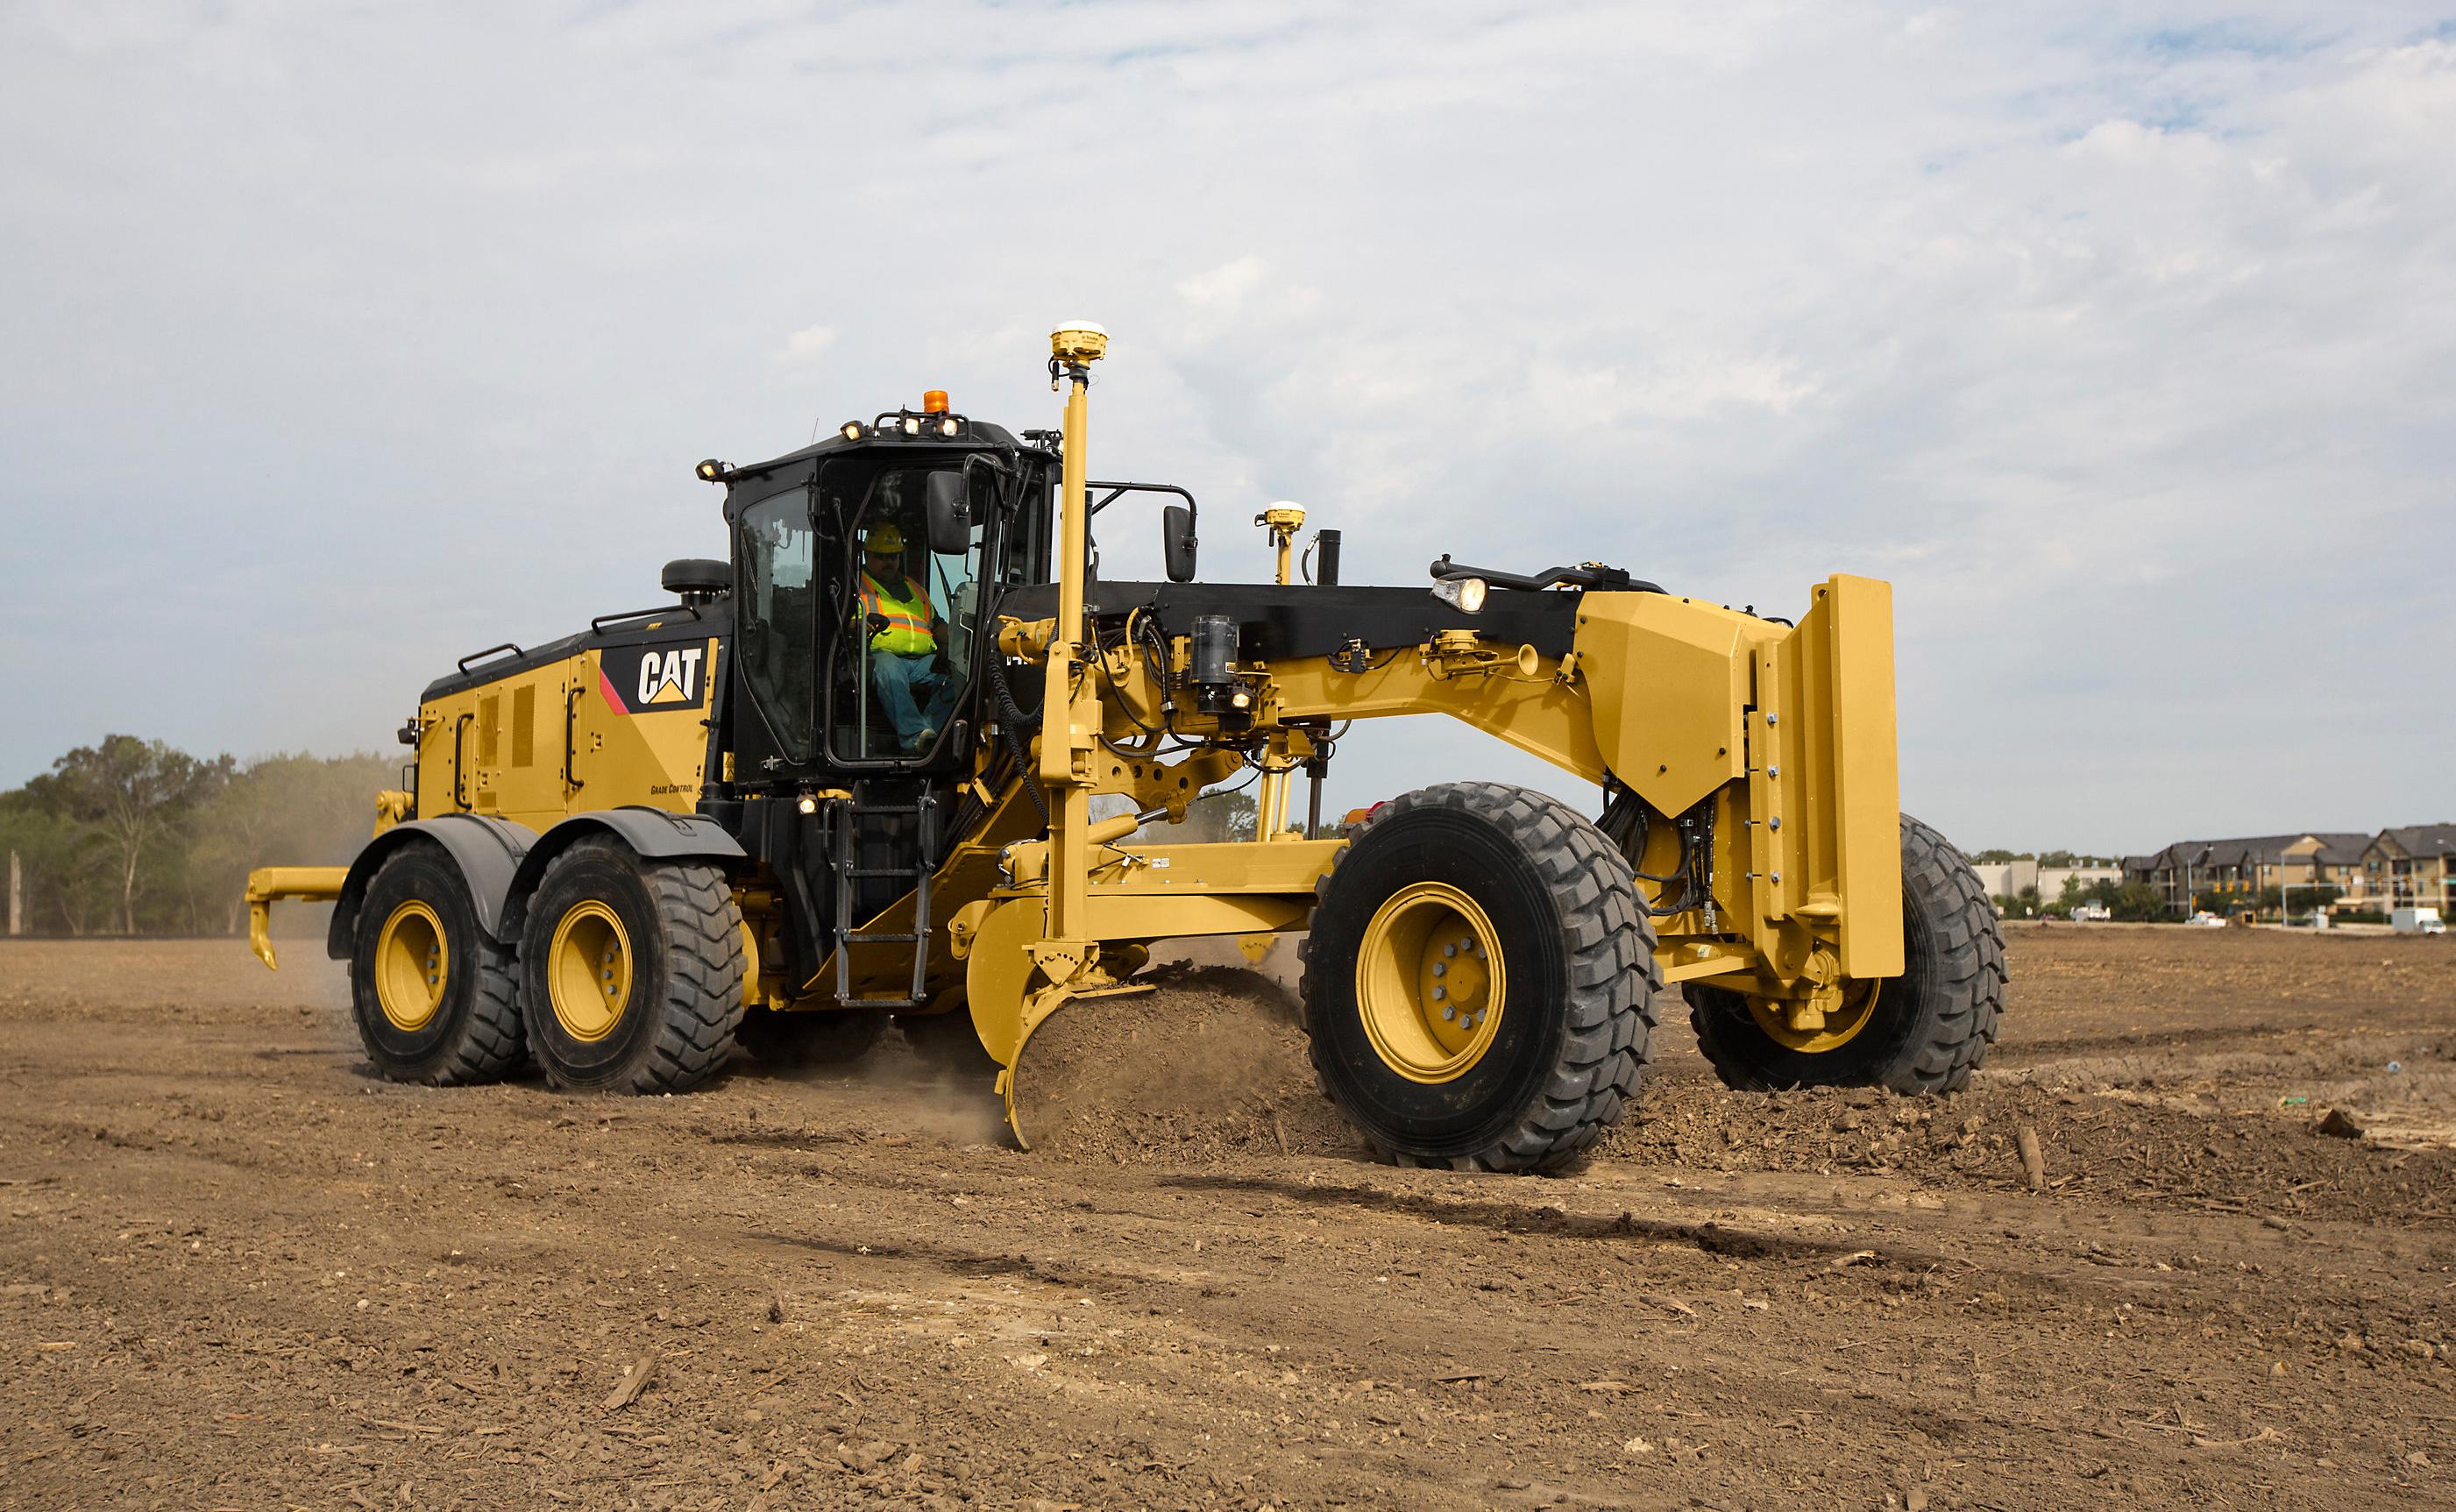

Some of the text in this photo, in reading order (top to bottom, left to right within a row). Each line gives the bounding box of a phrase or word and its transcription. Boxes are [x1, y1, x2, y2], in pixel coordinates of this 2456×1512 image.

[638, 648, 702, 704] CAT
[650, 784, 693, 795] GRADE CONTROL
